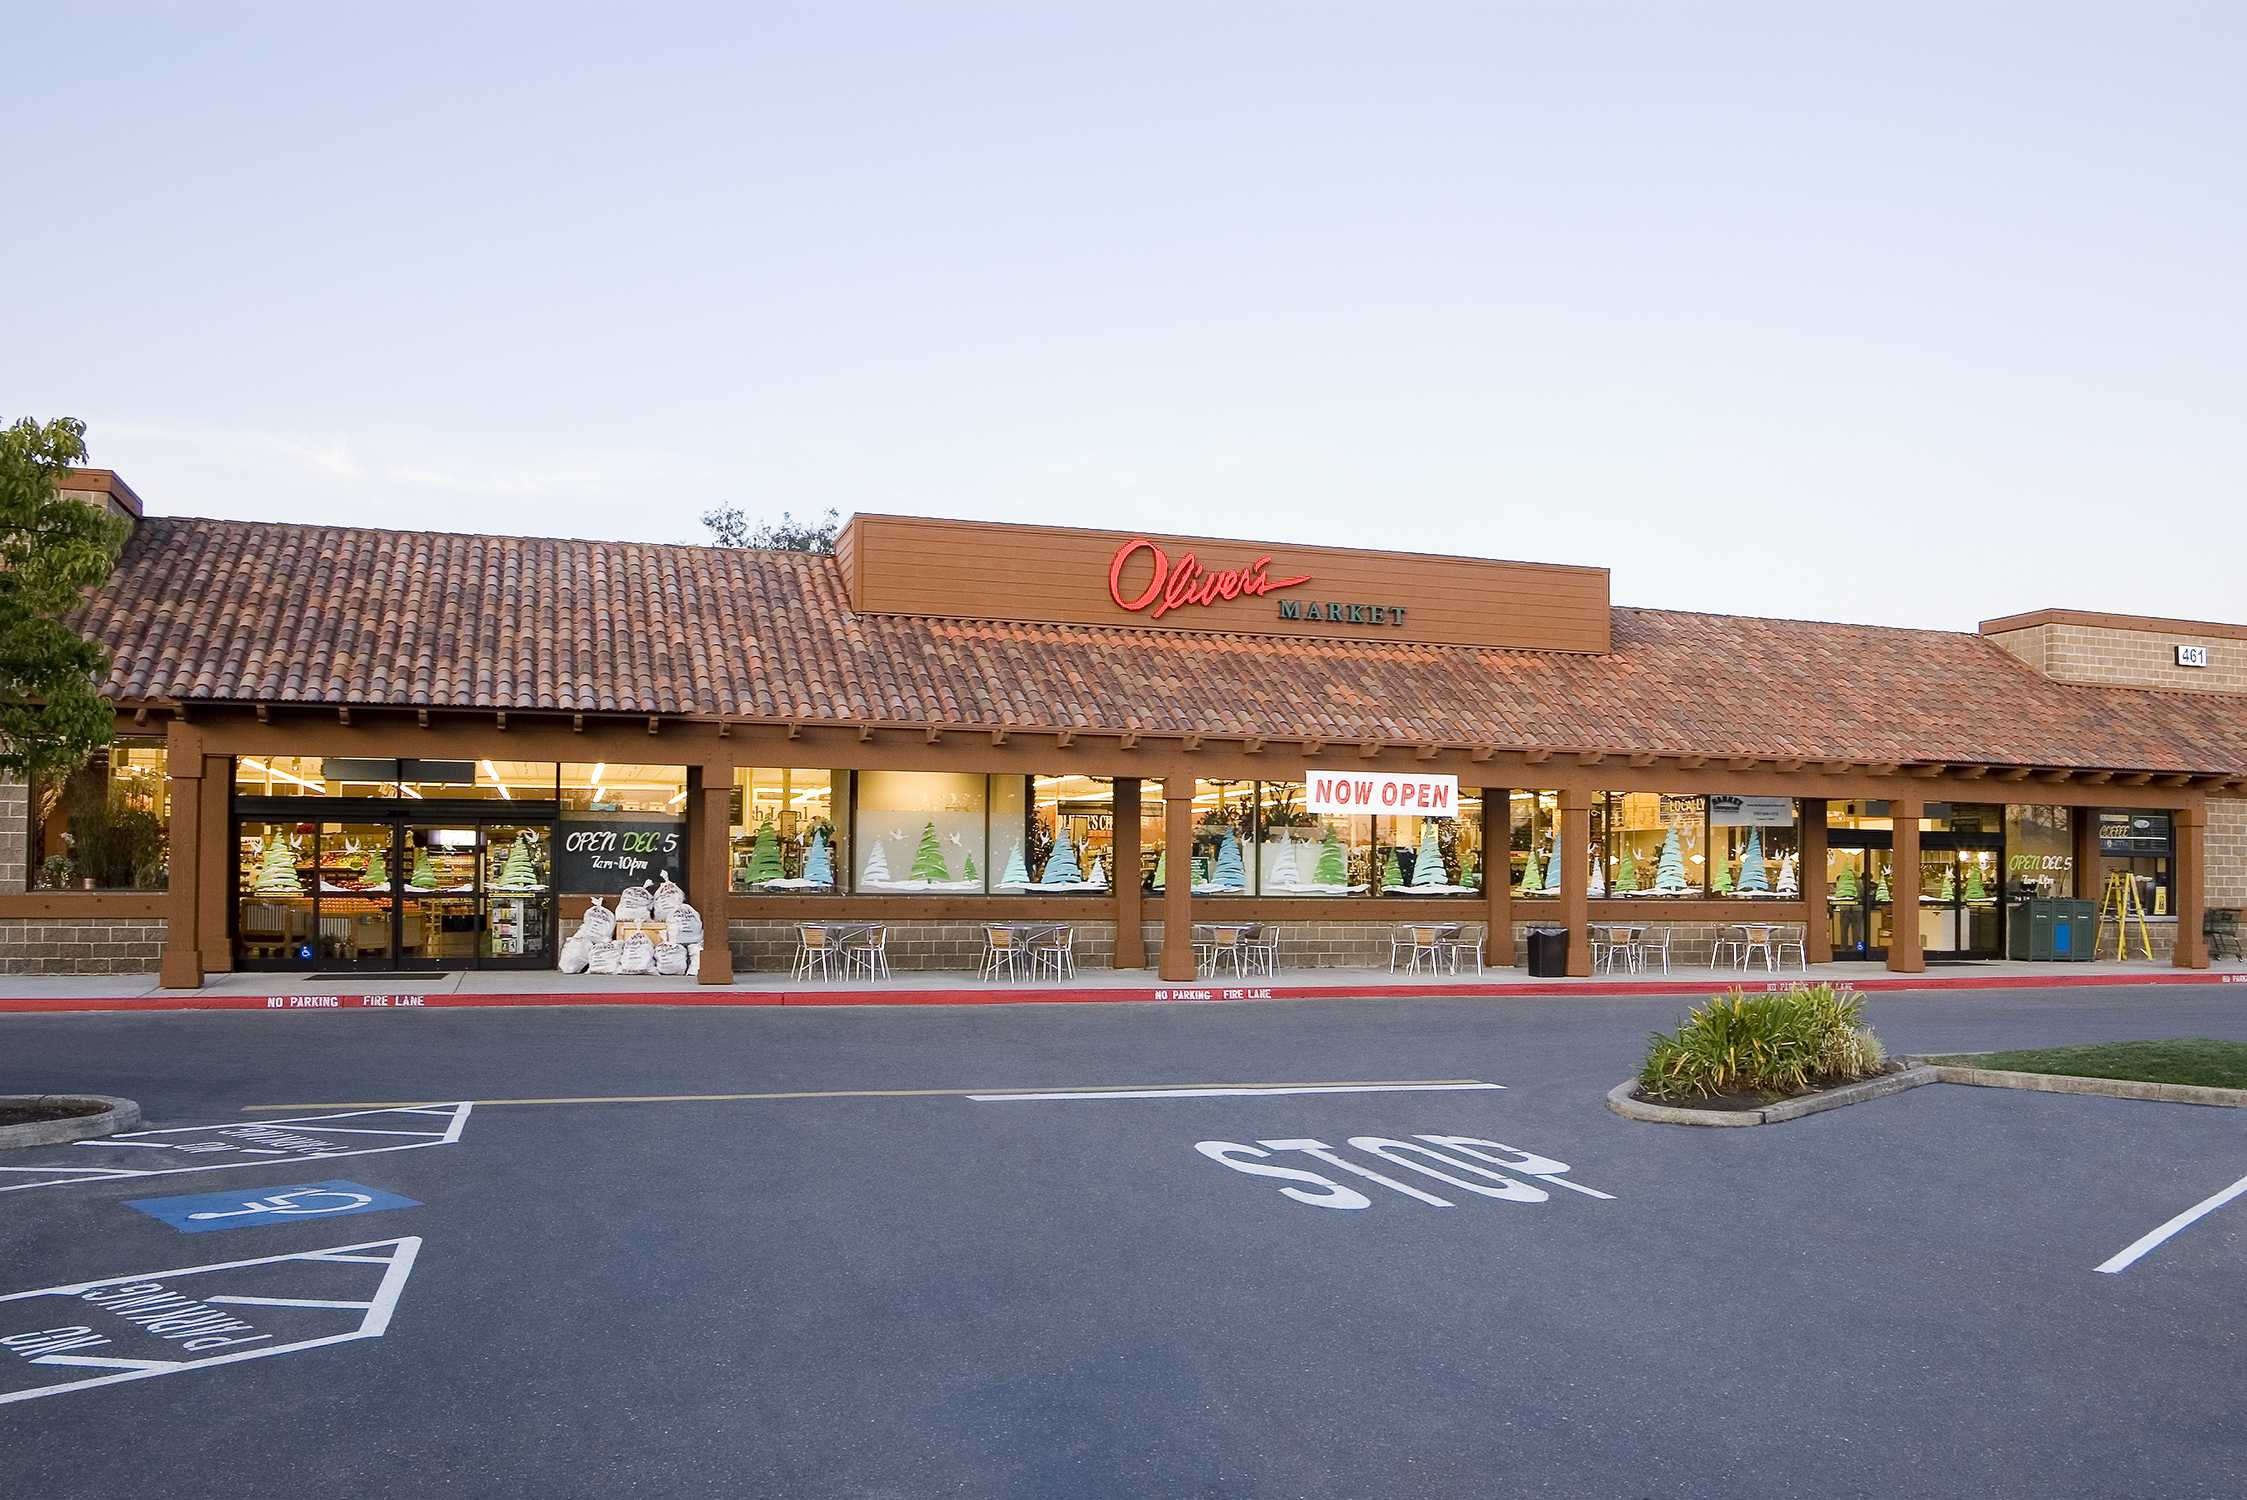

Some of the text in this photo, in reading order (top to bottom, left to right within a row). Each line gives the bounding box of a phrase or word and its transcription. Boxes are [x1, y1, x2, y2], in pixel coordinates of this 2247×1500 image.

[1109, 537, 1313, 619] Oliver's
[1279, 599, 1407, 625] MARKET
[2182, 648, 2203, 664] 461
[1315, 779, 1449, 808] NOW OPEN
[1670, 797, 1705, 813] LOCALLY
[2100, 824, 2130, 837] COFFEE
[566, 831, 680, 853] OPEN DEC. 5
[2009, 854, 2041, 870] OPEN
[2063, 856, 2073, 870] 5
[267, 994, 425, 1008] NO PARKING FIRE LANE
[1154, 988, 1271, 1000] NO PARKING FIRE LANE
[1193, 1134, 1619, 1210] STOP
[82, 1283, 274, 1351] PARKING
[0, 1326, 112, 1357] NO
